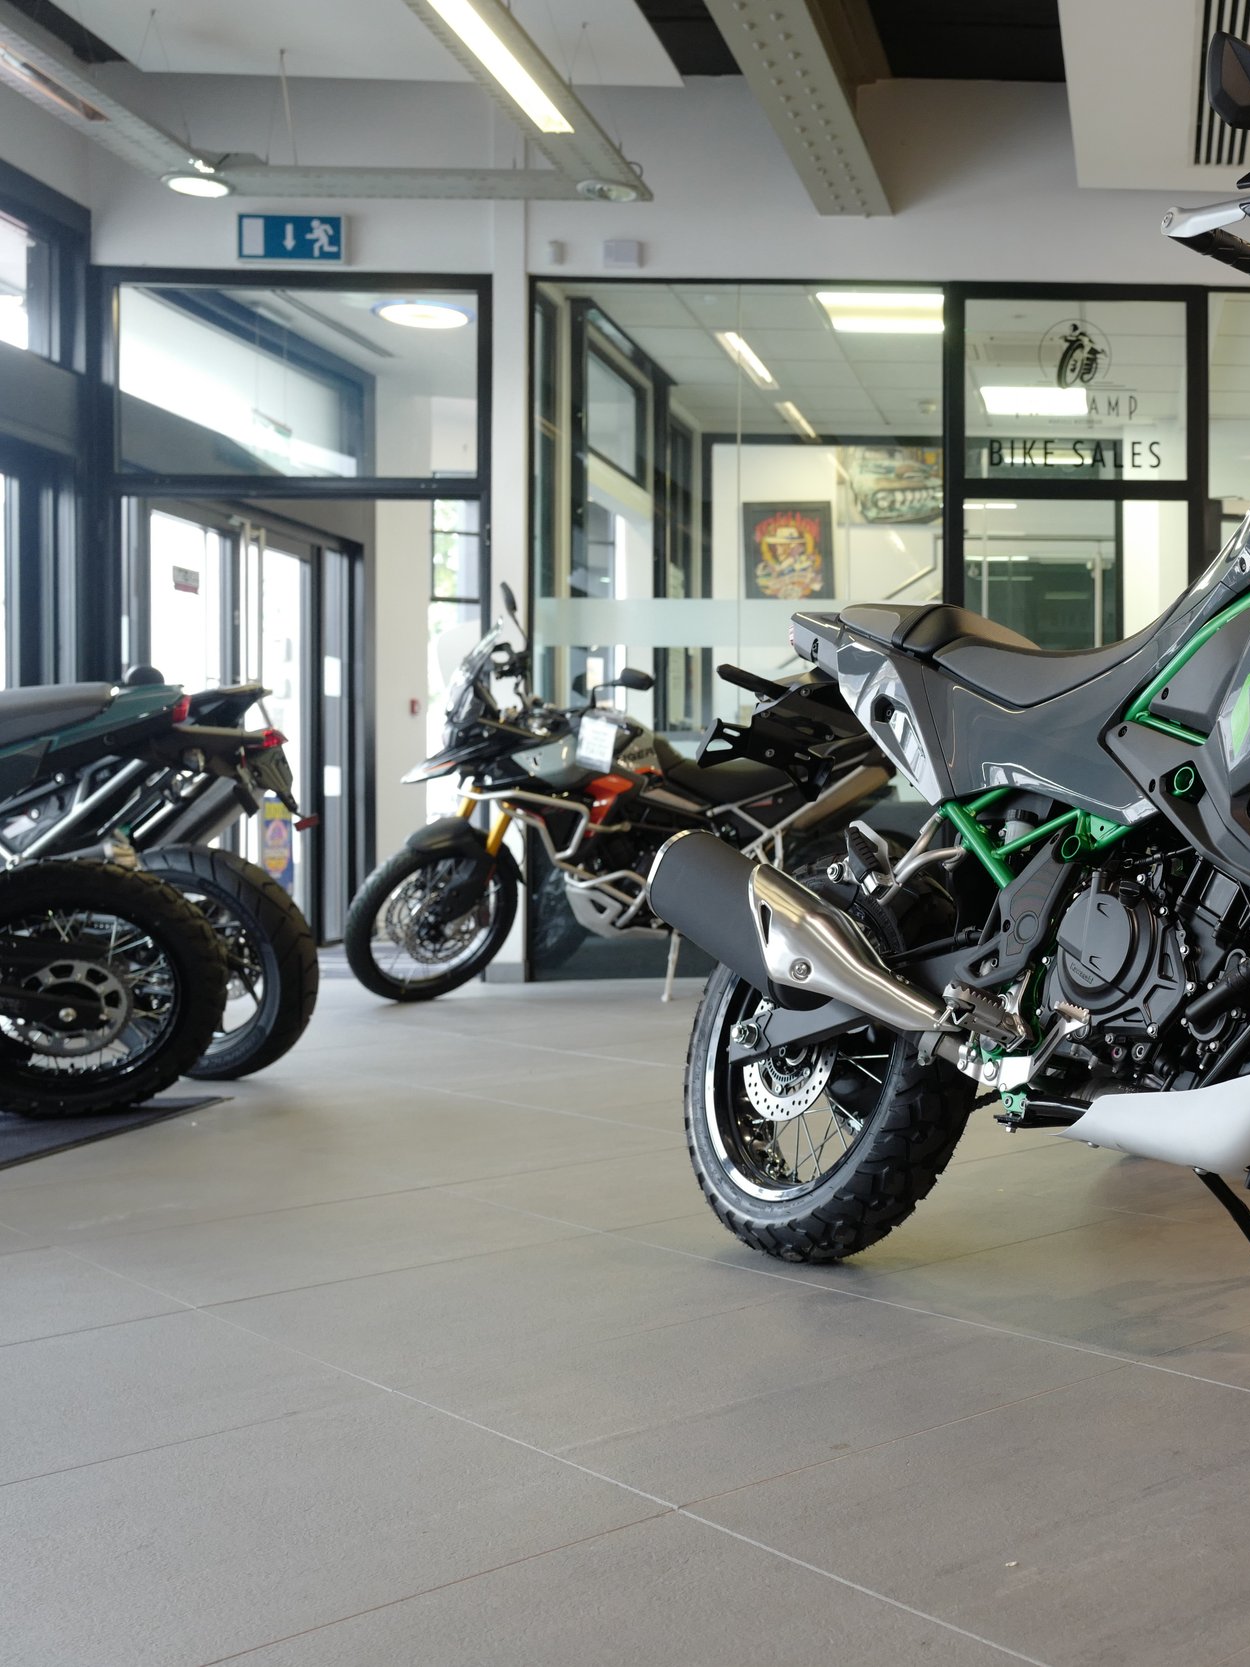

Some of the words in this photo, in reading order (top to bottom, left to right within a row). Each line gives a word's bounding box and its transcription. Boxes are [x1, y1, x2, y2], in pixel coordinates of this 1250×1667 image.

[1089, 395, 1138, 421] AMP
[989, 439, 1056, 467] BIKE
[1072, 440, 1161, 469] SALES
[617, 747, 656, 763] IGER
